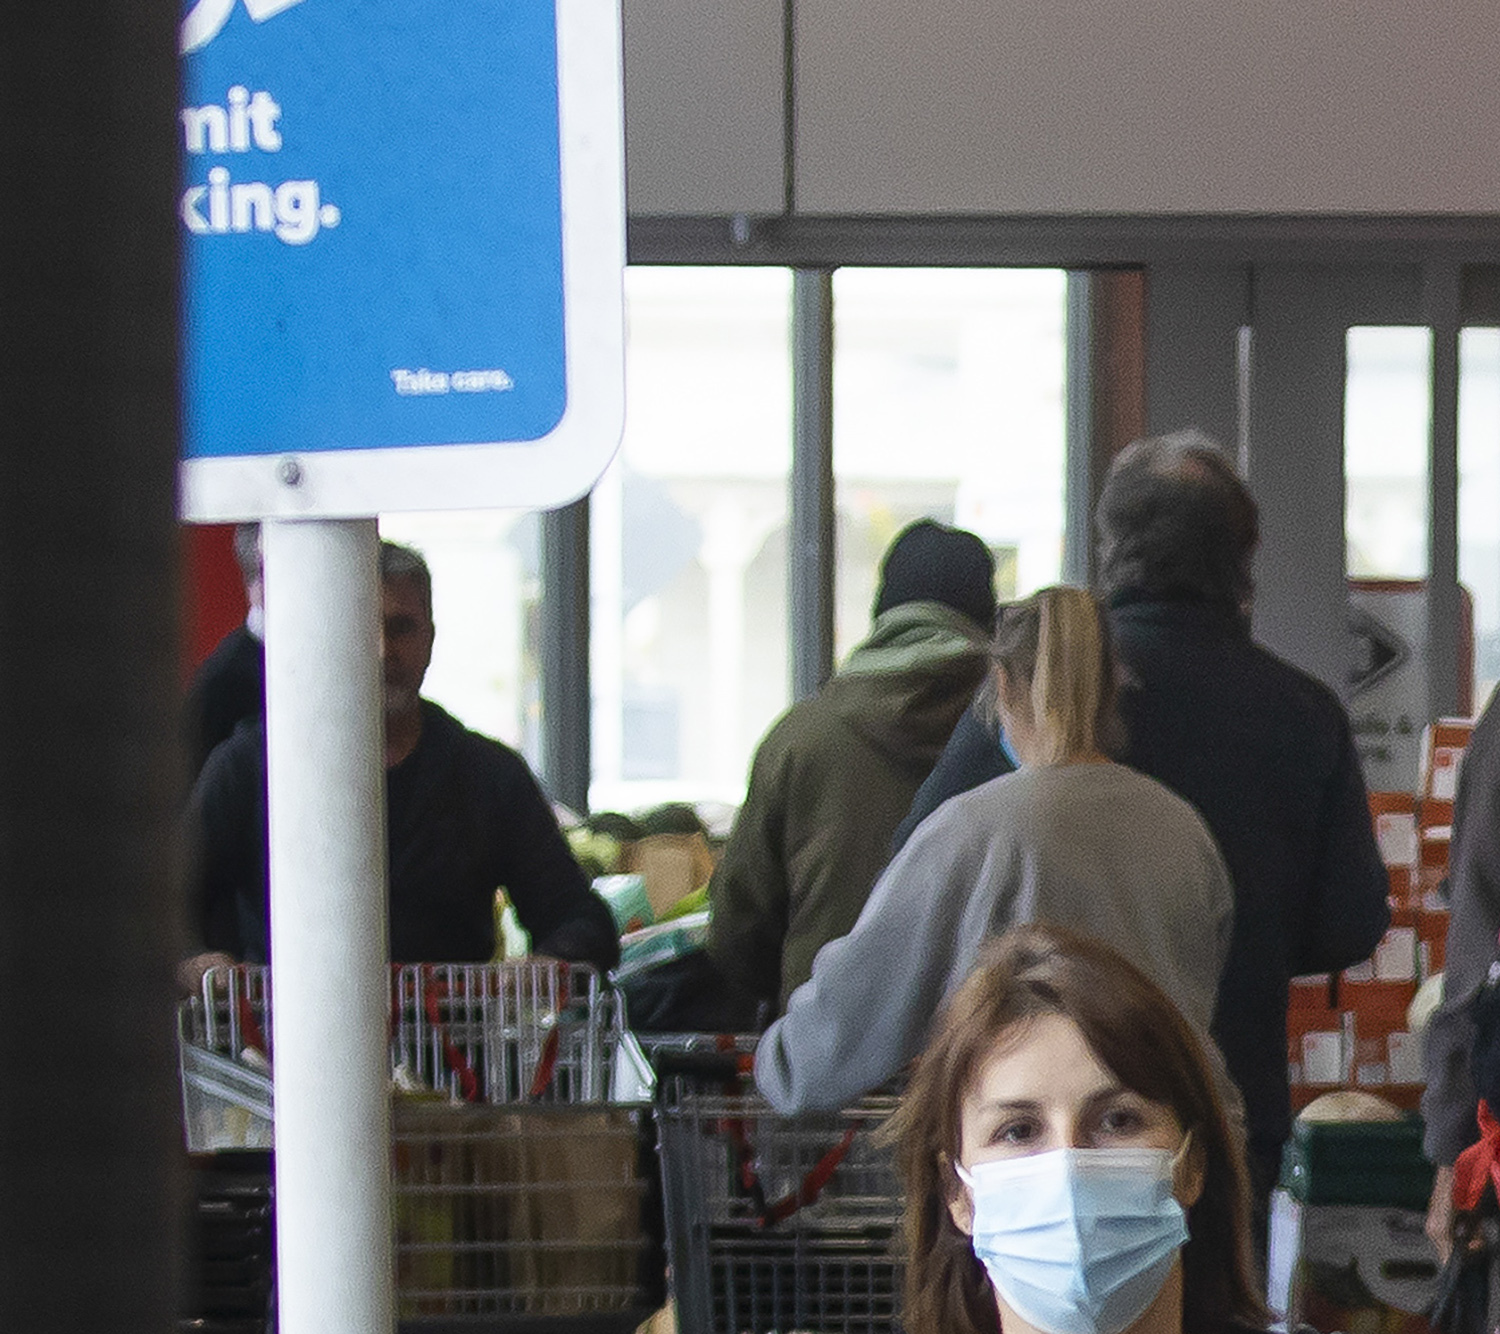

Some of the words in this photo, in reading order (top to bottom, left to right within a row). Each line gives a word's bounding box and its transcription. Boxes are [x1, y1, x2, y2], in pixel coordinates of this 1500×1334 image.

[179, 165, 342, 247] king.
[389, 367, 450, 397] Take
[451, 369, 514, 392] care.
